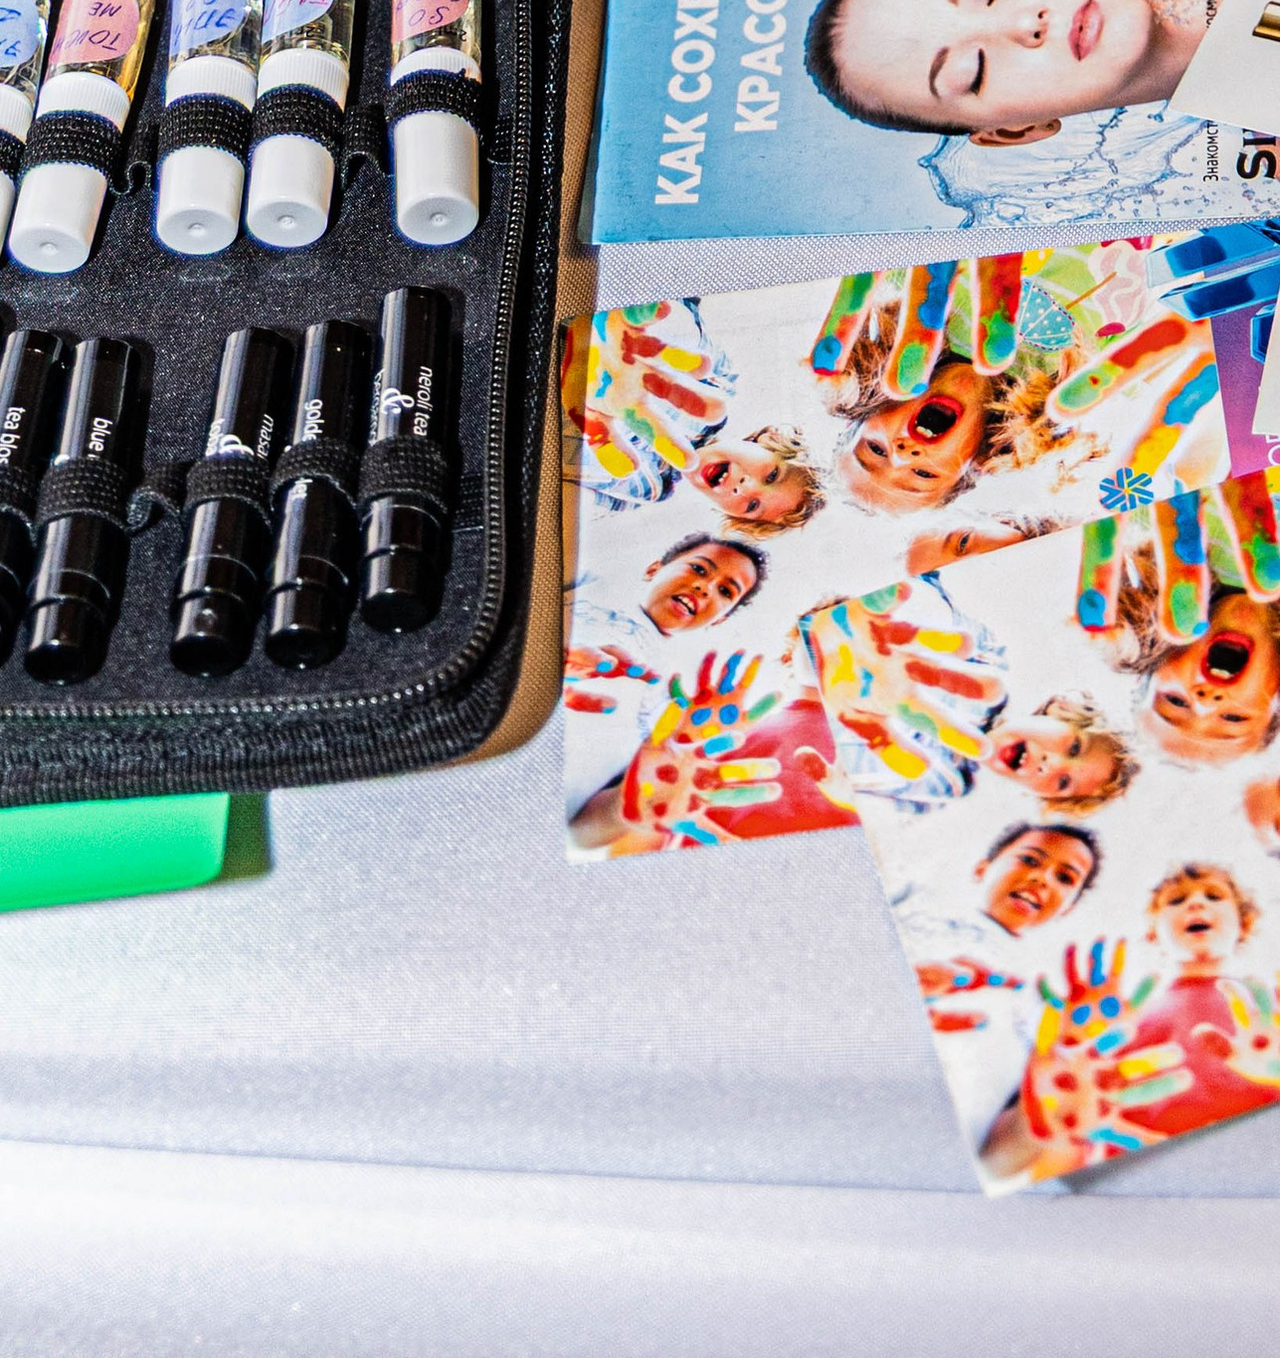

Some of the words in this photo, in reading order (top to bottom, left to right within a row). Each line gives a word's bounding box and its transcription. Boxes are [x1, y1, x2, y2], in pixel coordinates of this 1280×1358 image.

[88, 1, 122, 17] ME
[652, 110, 710, 206] КАК
[1202, 120, 1219, 182] Знакомст
[416, 365, 434, 412] neroli
[3, 406, 26, 431] tea
[88, 417, 113, 452] blue
[413, 416, 431, 437] tea
[0, 432, 21, 464] blos
